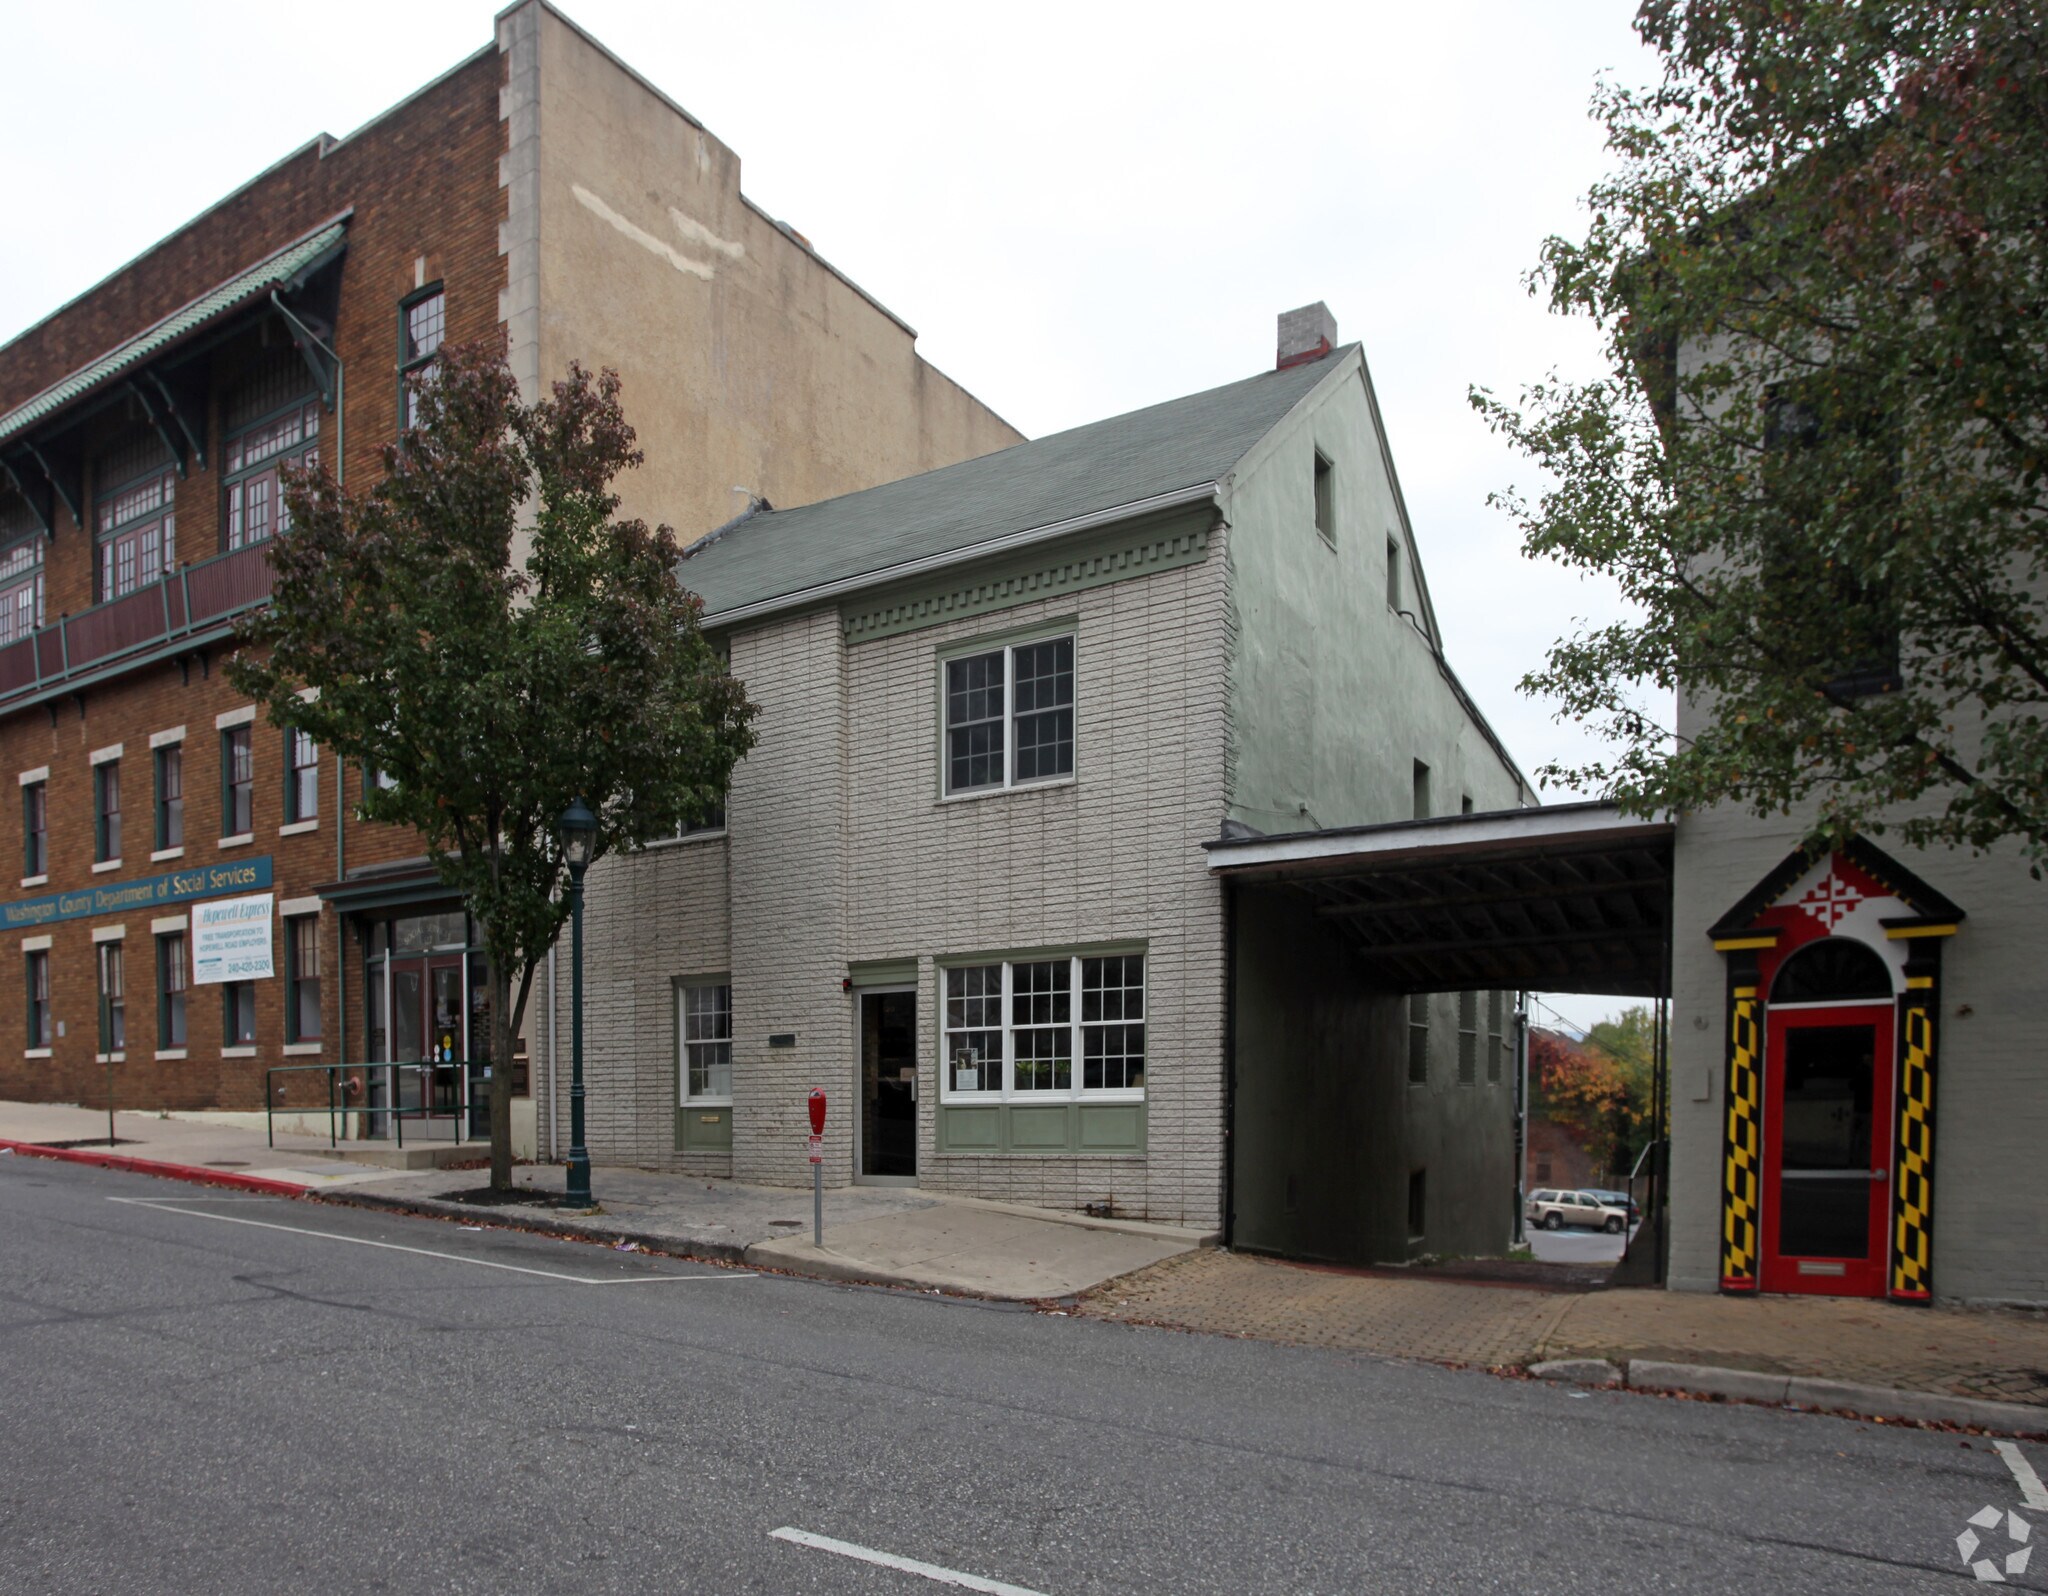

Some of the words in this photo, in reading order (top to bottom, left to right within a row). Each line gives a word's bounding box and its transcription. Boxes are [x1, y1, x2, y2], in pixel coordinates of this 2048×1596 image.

[6, 902, 55, 922] Washington
[59, 896, 92, 914] County
[96, 885, 153, 910] Department
[157, 877, 168, 897] of
[173, 871, 205, 895] Social
[210, 867, 255, 888] Services
[203, 904, 237, 924] Hopewell
[239, 901, 270, 918] Express
